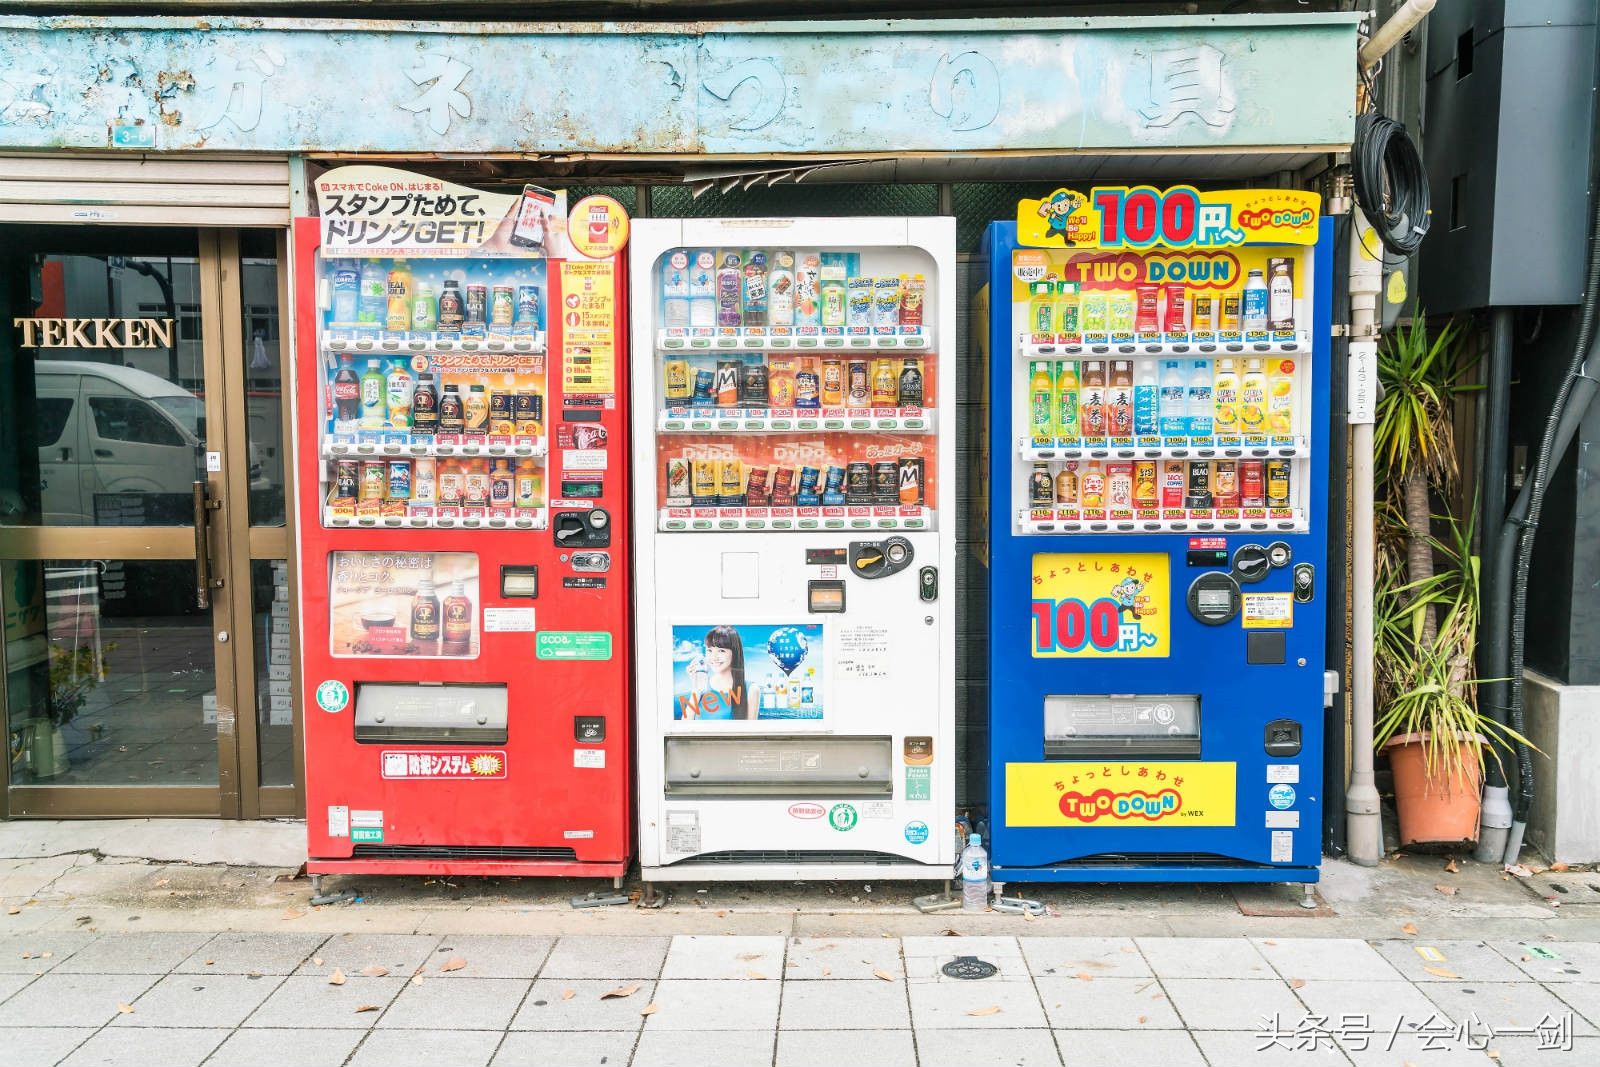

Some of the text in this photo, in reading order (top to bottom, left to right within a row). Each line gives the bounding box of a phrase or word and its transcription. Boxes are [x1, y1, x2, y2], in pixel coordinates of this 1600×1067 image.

[325, 193, 486, 217] スタンプためて、
[1068, 216, 1087, 224] We'll
[1068, 224, 1079, 232] Be
[1242, 211, 1311, 226] TWO DOWN
[325, 220, 484, 245] ドリンクGET!
[1068, 231, 1096, 241] Happy!
[1076, 261, 1229, 282] TWO DOWN
[14, 318, 174, 348] TEKKEN
[1090, 392, 1102, 424] 麦茶
[1117, 392, 1129, 424] 麦茶
[339, 556, 432, 569] おいしさの秘密は
[1032, 561, 1153, 585] ちょっとしあわせ
[679, 686, 742, 719] New
[1054, 765, 1184, 792] ちょっとしあわせ
[1066, 797, 1109, 817] TWO
[1117, 795, 1174, 815] DOWN
